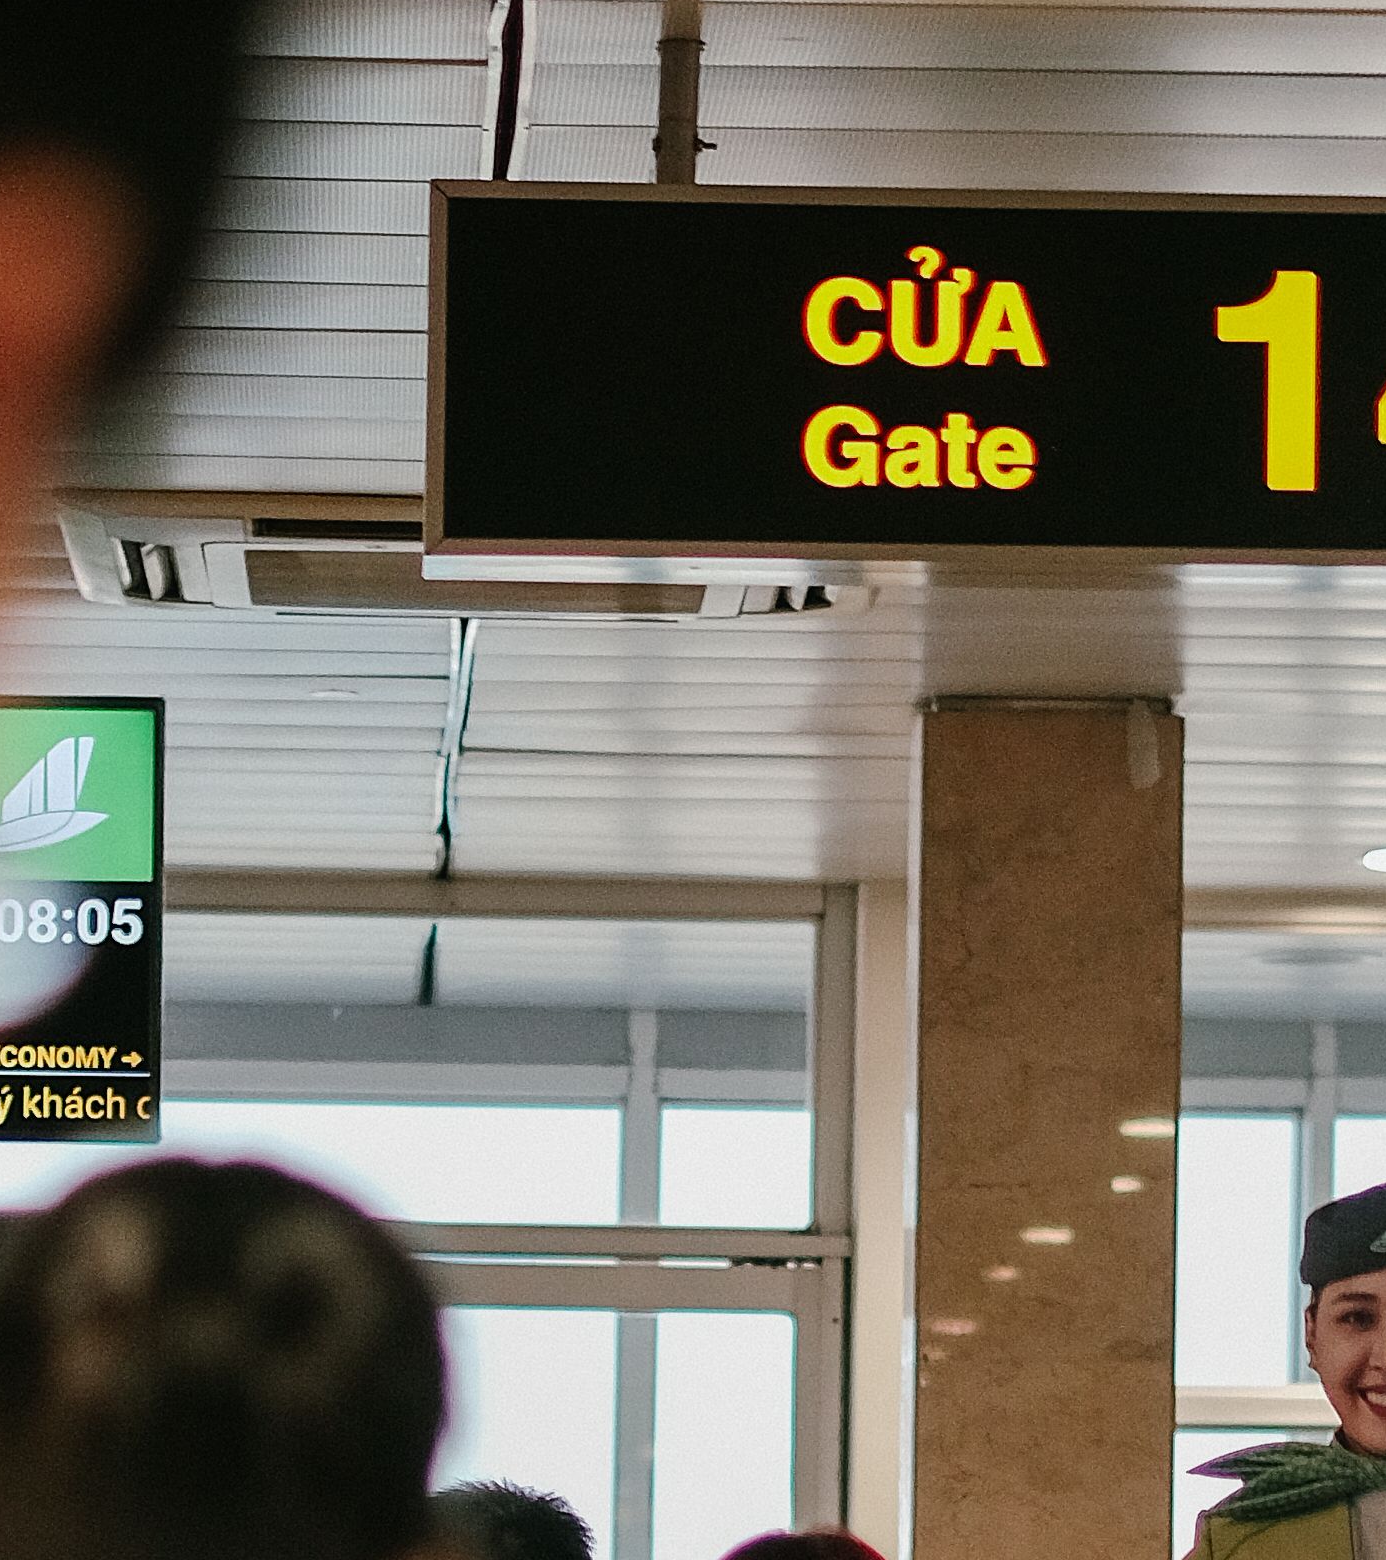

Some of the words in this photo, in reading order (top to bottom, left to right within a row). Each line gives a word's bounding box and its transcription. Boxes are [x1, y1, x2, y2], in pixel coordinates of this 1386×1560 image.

[805, 246, 1047, 369] CỬA
[805, 405, 1037, 491] Gate
[23, 1086, 126, 1120] khách
